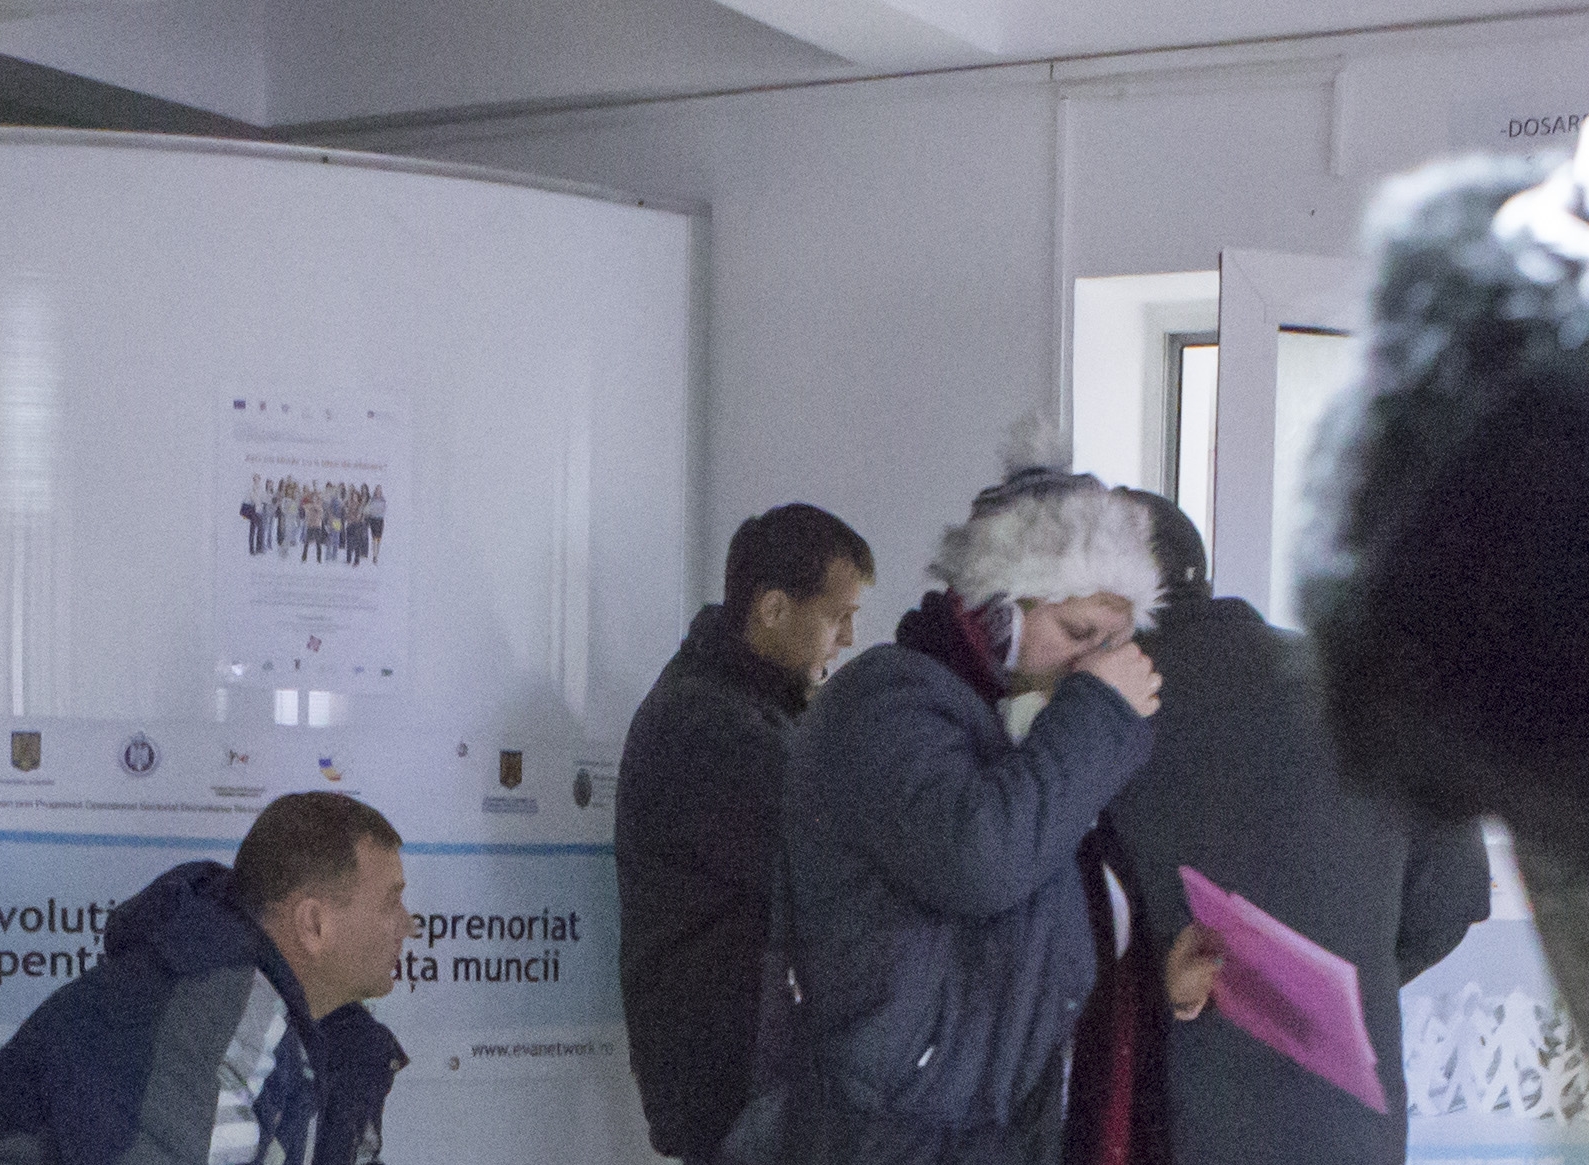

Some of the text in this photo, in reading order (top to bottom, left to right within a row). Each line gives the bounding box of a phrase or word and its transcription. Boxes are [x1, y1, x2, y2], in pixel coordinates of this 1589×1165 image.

[1500, 113, 1589, 138] -DOSAR
[410, 906, 582, 949] eprenoriat
[391, 950, 439, 993] ața
[453, 949, 561, 983] muncii
